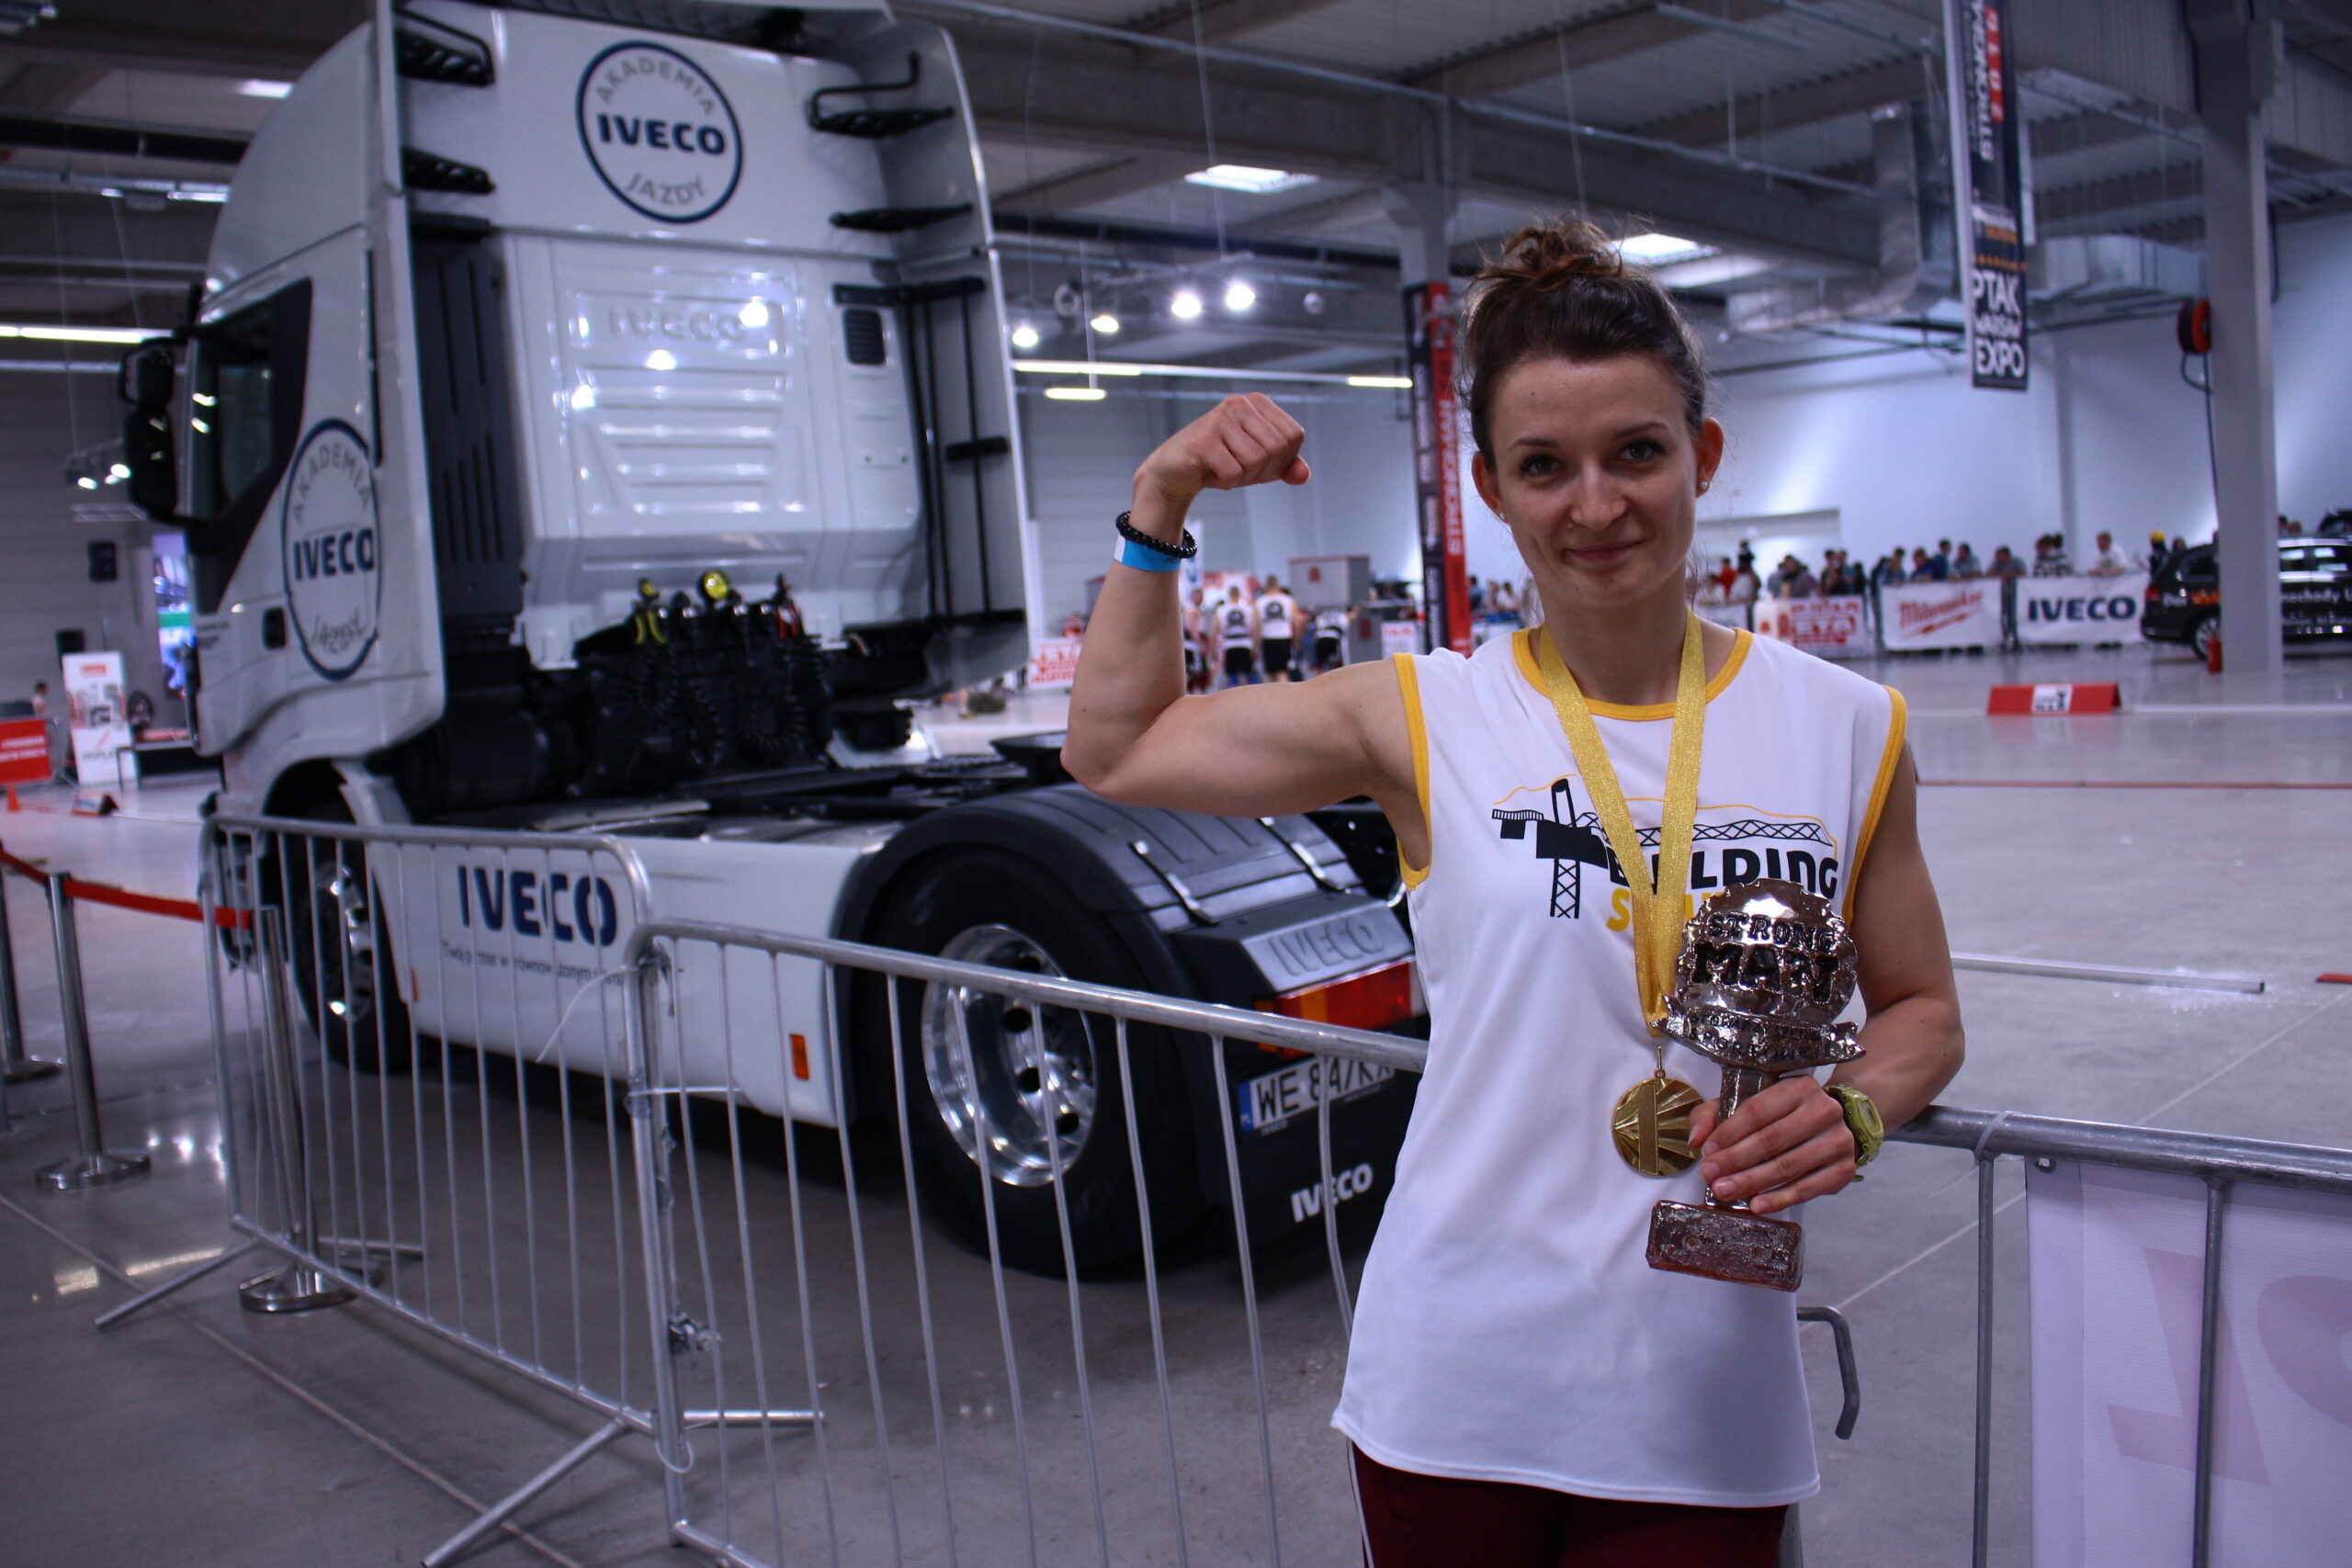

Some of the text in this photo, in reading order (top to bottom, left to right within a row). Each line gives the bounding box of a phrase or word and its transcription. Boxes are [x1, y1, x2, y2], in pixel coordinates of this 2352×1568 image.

[597, 56, 716, 116] AKADEMIA
[596, 113, 726, 155] IVECO
[627, 173, 706, 206] JAZDY
[1972, 271, 2020, 316] PTAK
[608, 309, 747, 343] IVECO
[1975, 339, 2025, 378] EXPO
[1439, 400, 1463, 556] STRONGMAN
[293, 528, 374, 581] IVECO
[2029, 597, 2136, 622] IVECO
[1610, 845, 1838, 899] BLDING
[458, 865, 617, 947] IVECO
[1270, 919, 1384, 976] IVECO
[1706, 912, 1838, 954] STRONG
[1691, 941, 1838, 1004] MAN
[1257, 1070, 1300, 1122] WE
